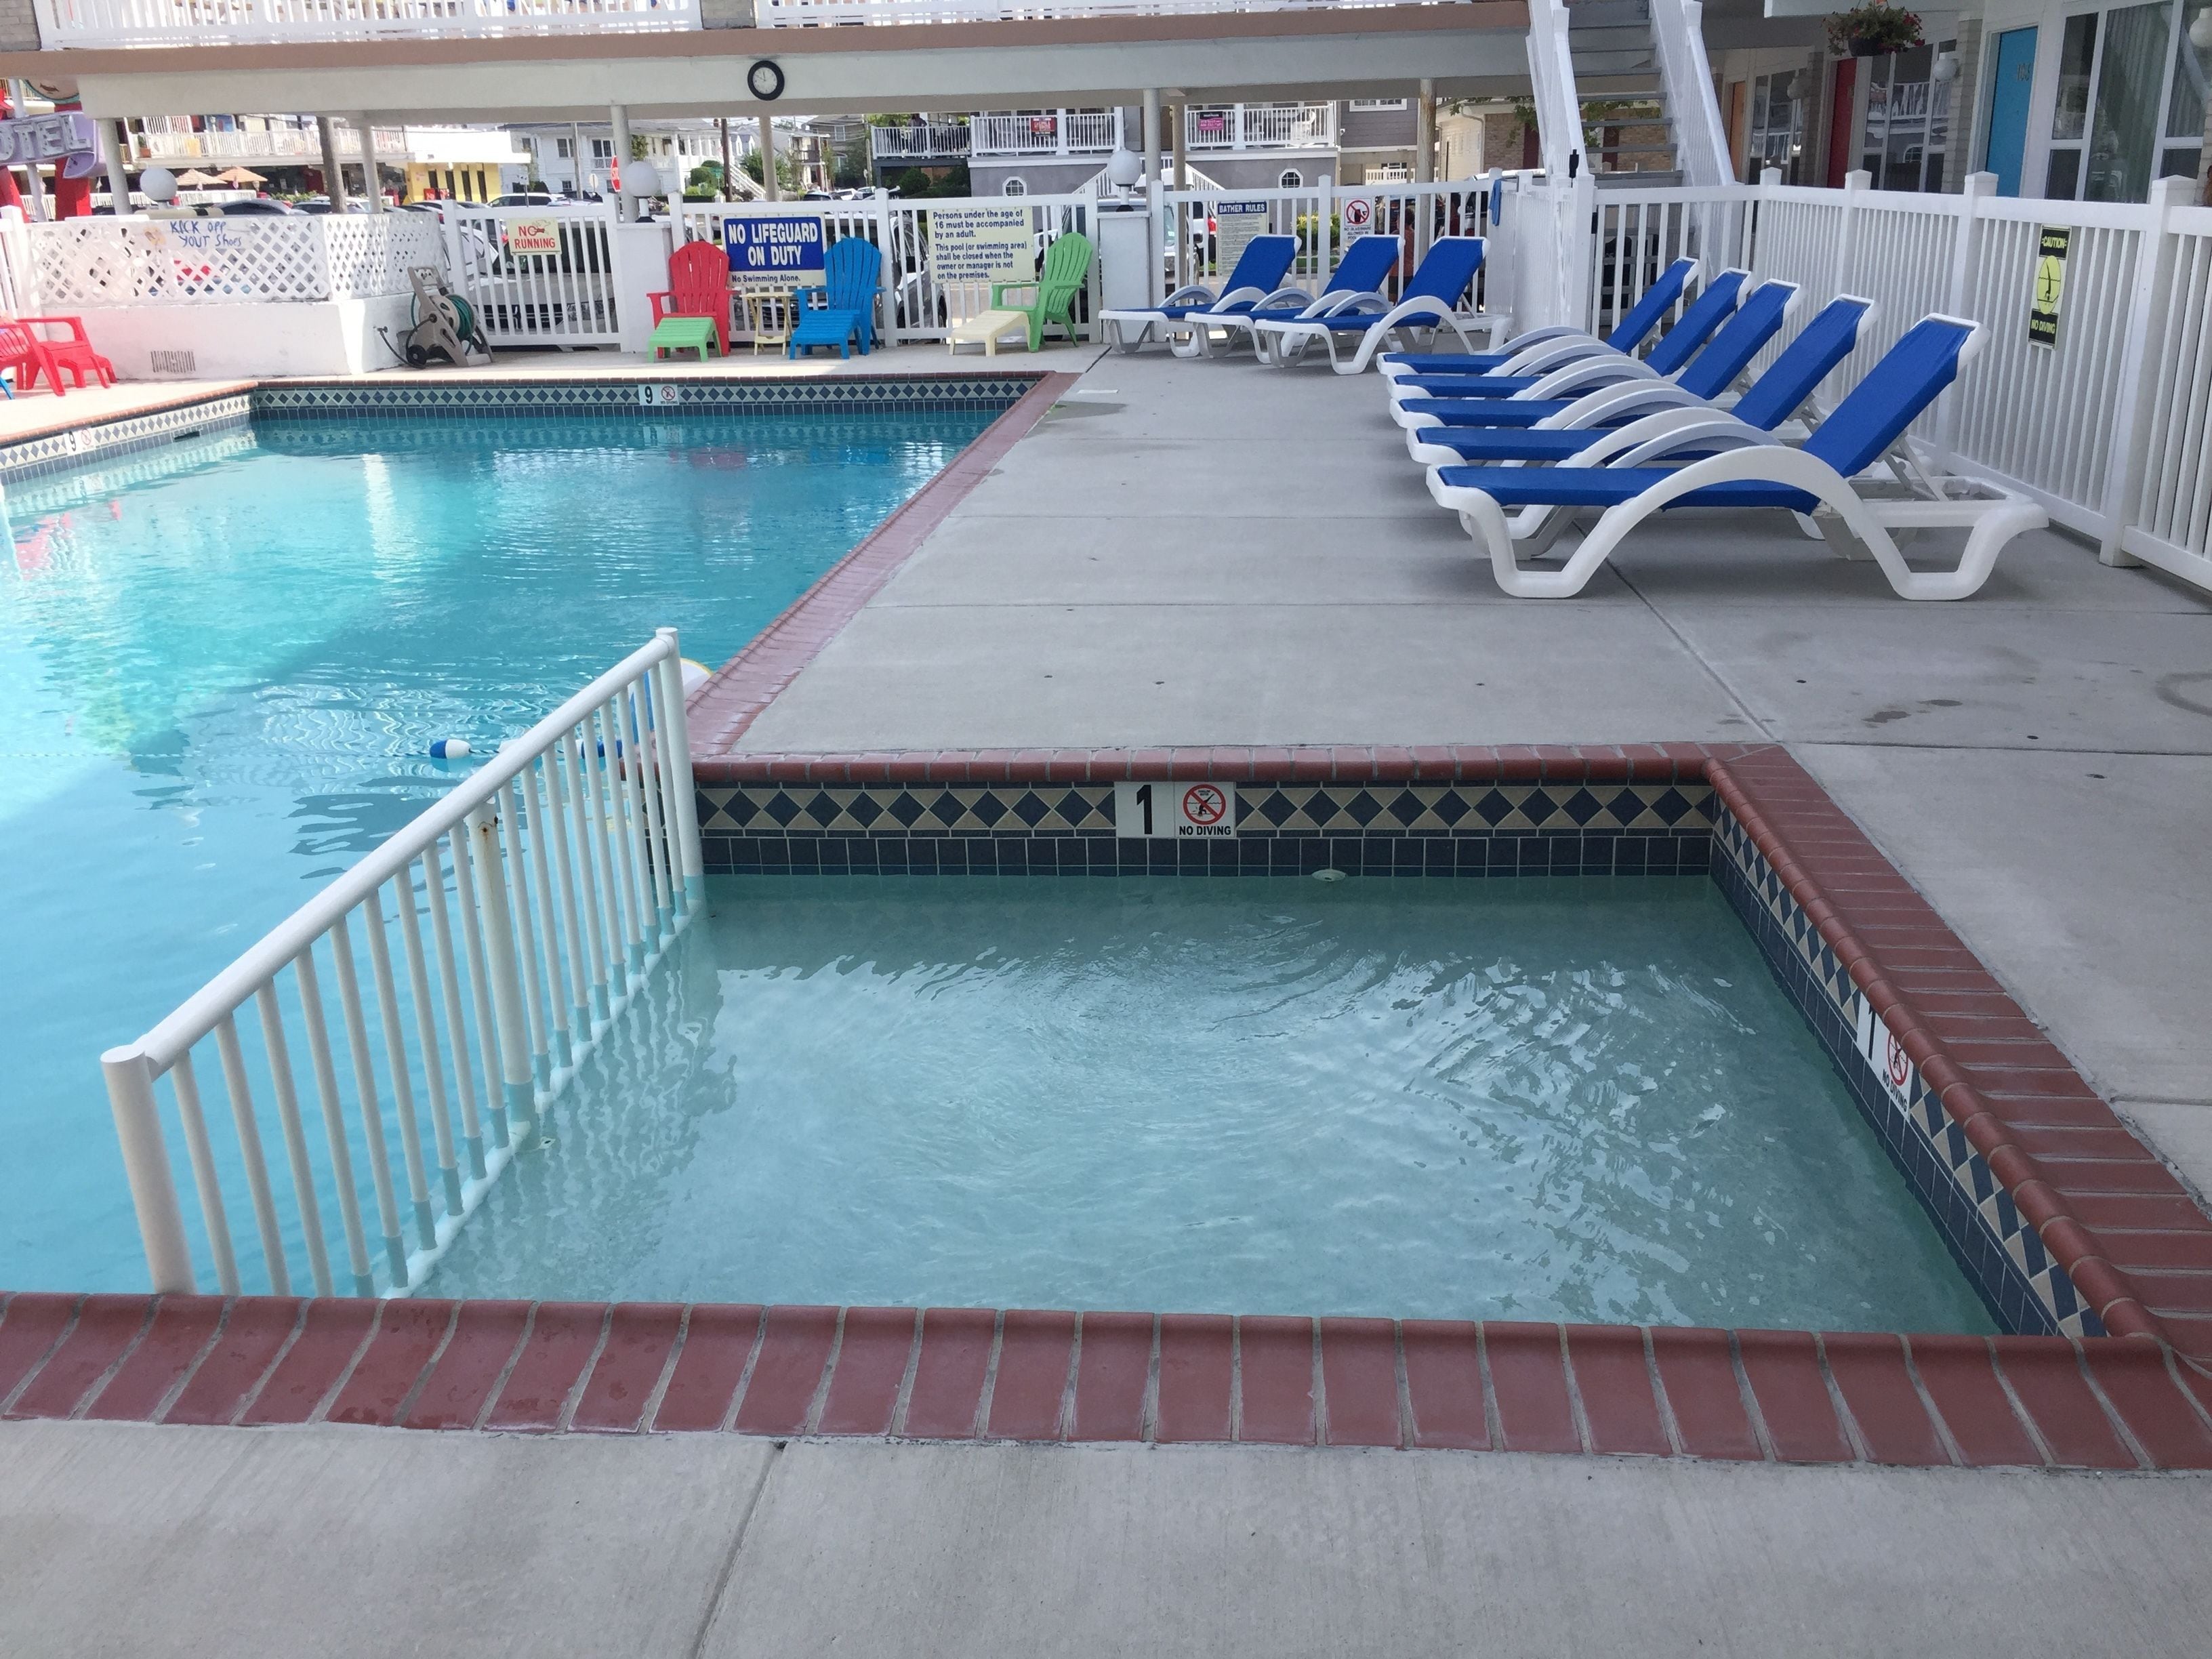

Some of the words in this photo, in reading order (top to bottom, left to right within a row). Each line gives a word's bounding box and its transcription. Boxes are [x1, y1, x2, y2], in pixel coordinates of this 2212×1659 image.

[1219, 205, 1243, 213] BATHER
[1246, 204, 1265, 212] RULES
[933, 211, 962, 220] Persons
[987, 210, 998, 218] the
[170, 220, 200, 234] KICK
[935, 221, 943, 229] 16
[966, 220, 974, 228] be
[977, 219, 1024, 228] accompanied
[518, 226, 537, 236] NO
[728, 224, 745, 244] NO
[752, 222, 818, 243] LIFEGUARD
[935, 231, 943, 240] by
[514, 238, 556, 249] RUNNING
[935, 243, 949, 251] This
[951, 243, 964, 253] pool
[966, 243, 974, 252] (or
[977, 242, 1008, 251] swimming
[1010, 241, 1027, 249] area)
[2043, 236, 2066, 249] CAUTION
[748, 247, 765, 266] ON
[771, 245, 802, 266] DUTY
[1003, 251, 1013, 259] the
[966, 262, 994, 271] manager
[743, 274, 778, 283] Swimming
[780, 274, 801, 282] Alone.
[959, 271, 989, 281] premises.
[2031, 319, 2039, 330] NO
[2039, 322, 2055, 333] DIVING
[644, 386, 653, 404] 9
[68, 430, 76, 451] 9
[1136, 784, 1152, 834] 1
[1179, 825, 1193, 835] NO
[1197, 825, 1231, 836] DIVING
[1883, 1069, 1889, 1088] NO
[1890, 1080, 1907, 1112] DIVING
